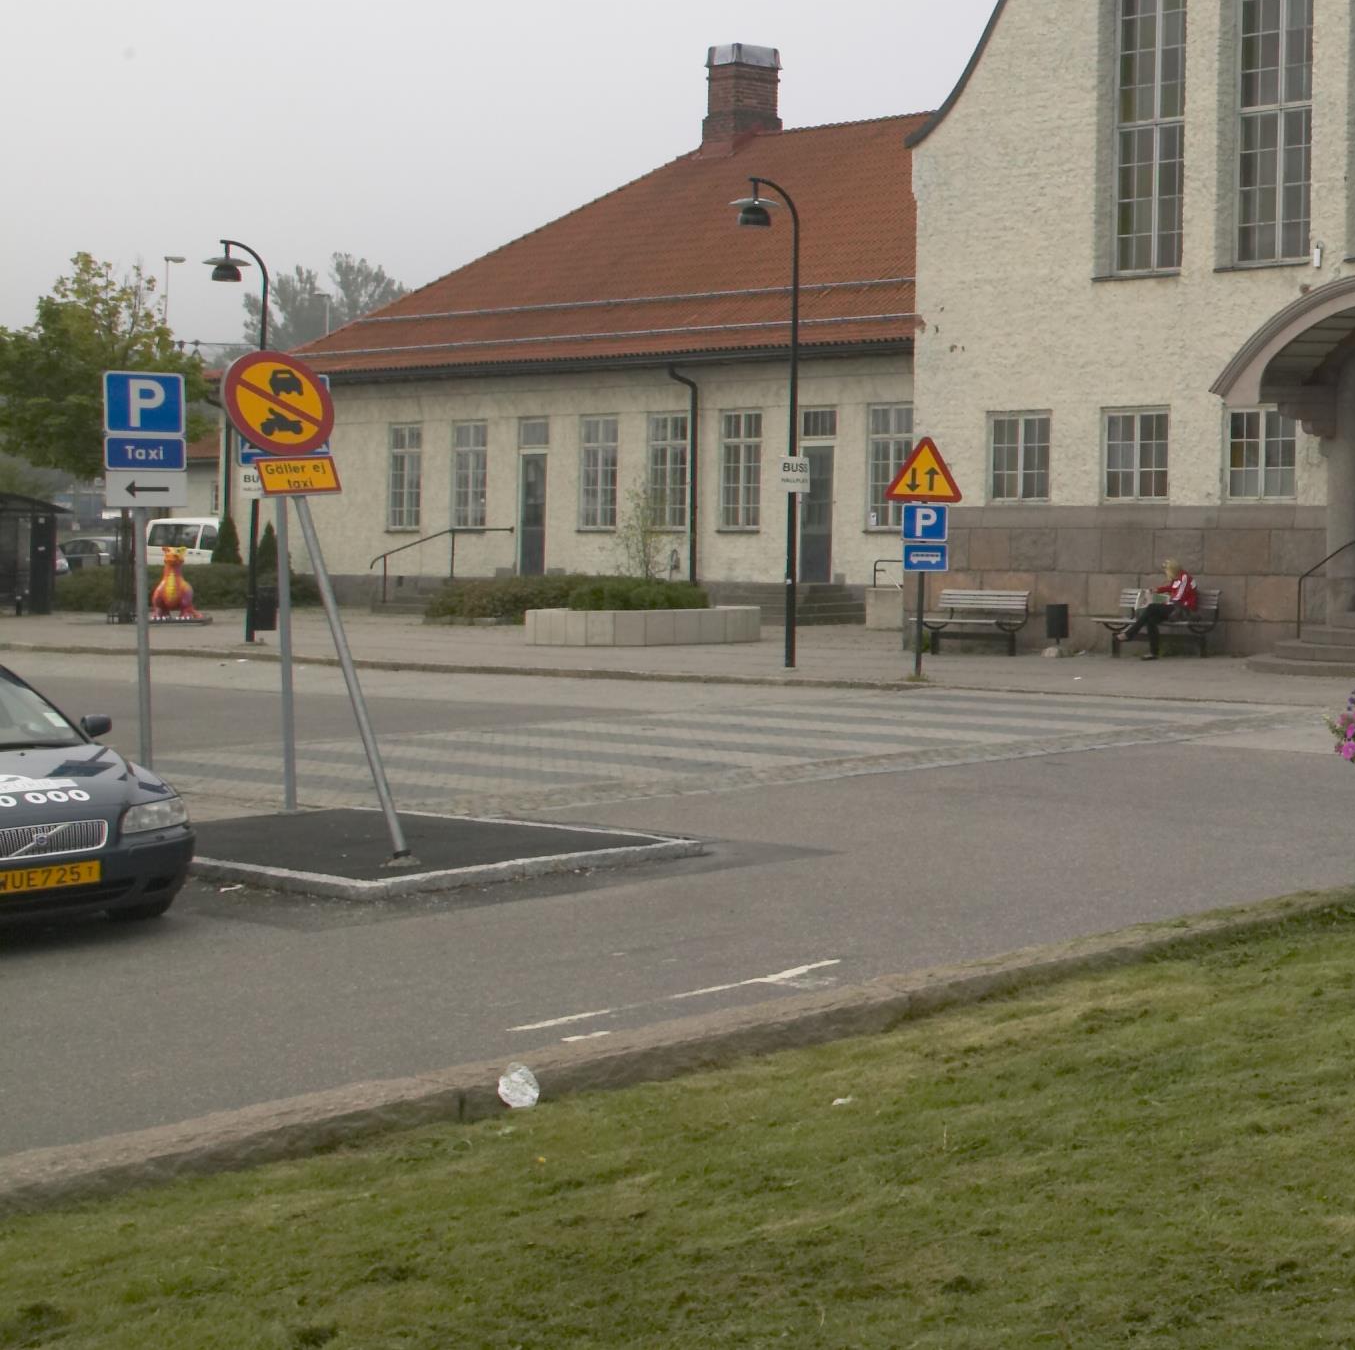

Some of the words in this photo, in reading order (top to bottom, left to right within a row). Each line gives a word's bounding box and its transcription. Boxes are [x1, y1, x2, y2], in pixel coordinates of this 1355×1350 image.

[128, 378, 166, 428] P
[124, 445, 164, 461] Taxi
[264, 463, 306, 475] Gäller
[312, 461, 327, 474] ej
[782, 462, 808, 473] BUSS
[286, 477, 315, 489] taxi
[914, 507, 938, 537] P
[23, 789, 91, 804] 000
